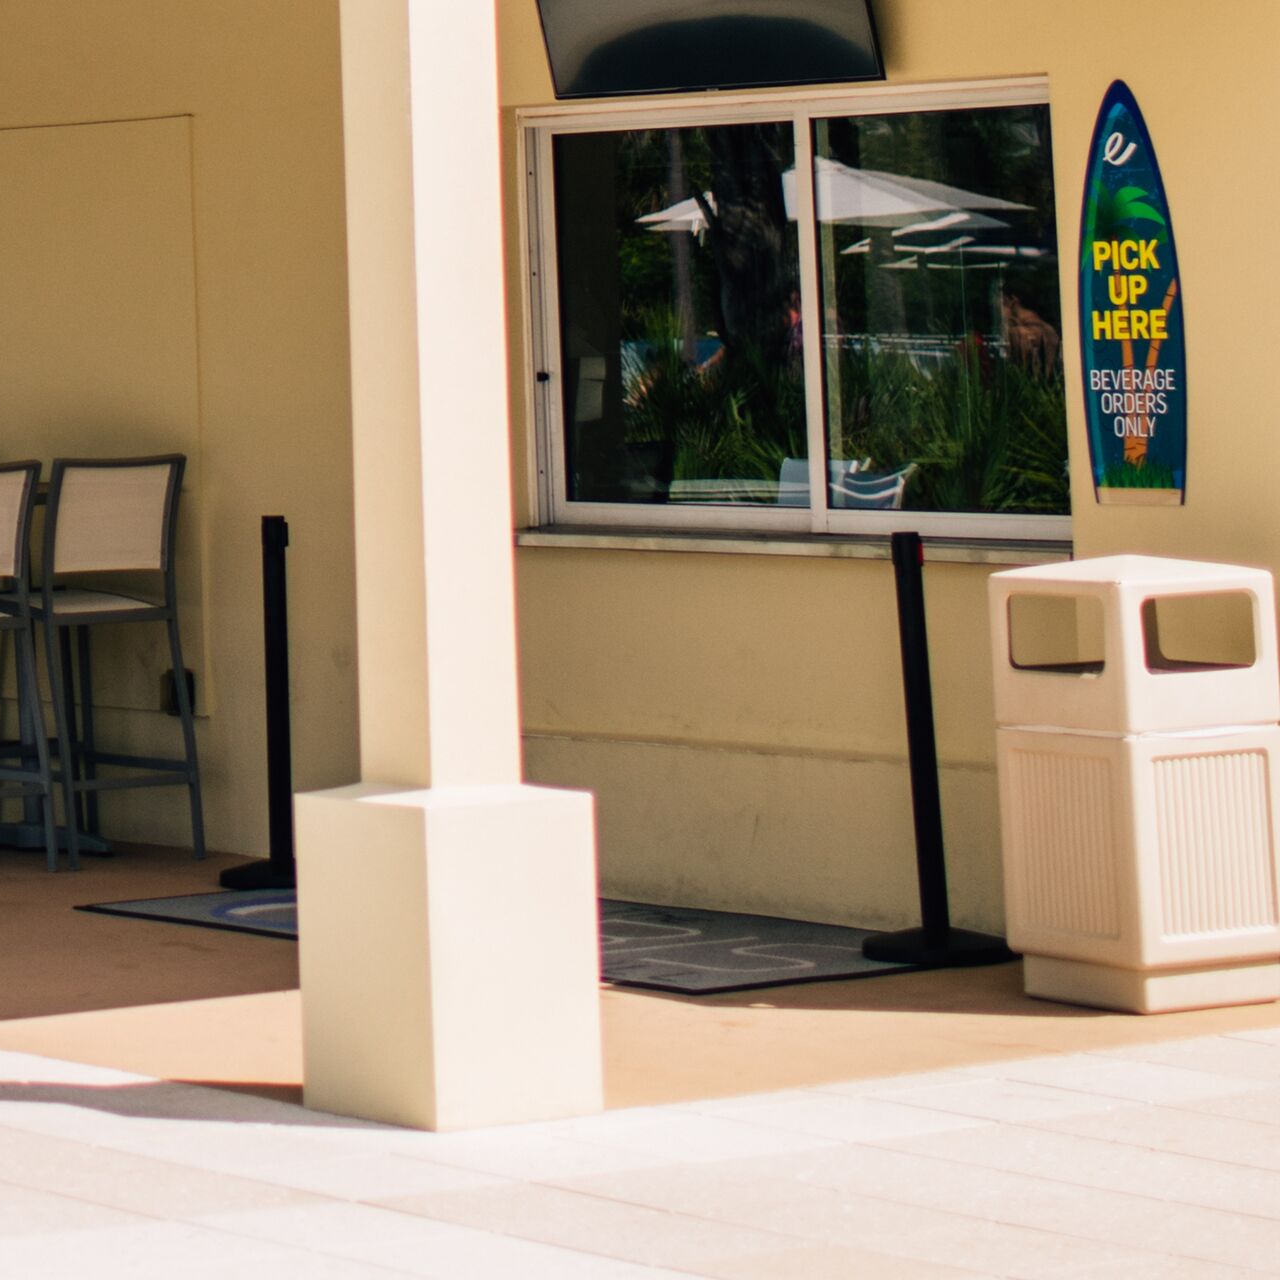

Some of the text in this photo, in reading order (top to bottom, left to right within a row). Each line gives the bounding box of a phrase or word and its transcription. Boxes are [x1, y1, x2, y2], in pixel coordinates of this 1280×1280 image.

[1092, 238, 1161, 271] PICK
[1108, 275, 1149, 306] UP
[1091, 308, 1169, 341] HERE
[1089, 368, 1176, 391] BEVERAGE
[1100, 391, 1168, 415] ORDERS
[1113, 415, 1156, 438] ONLY
